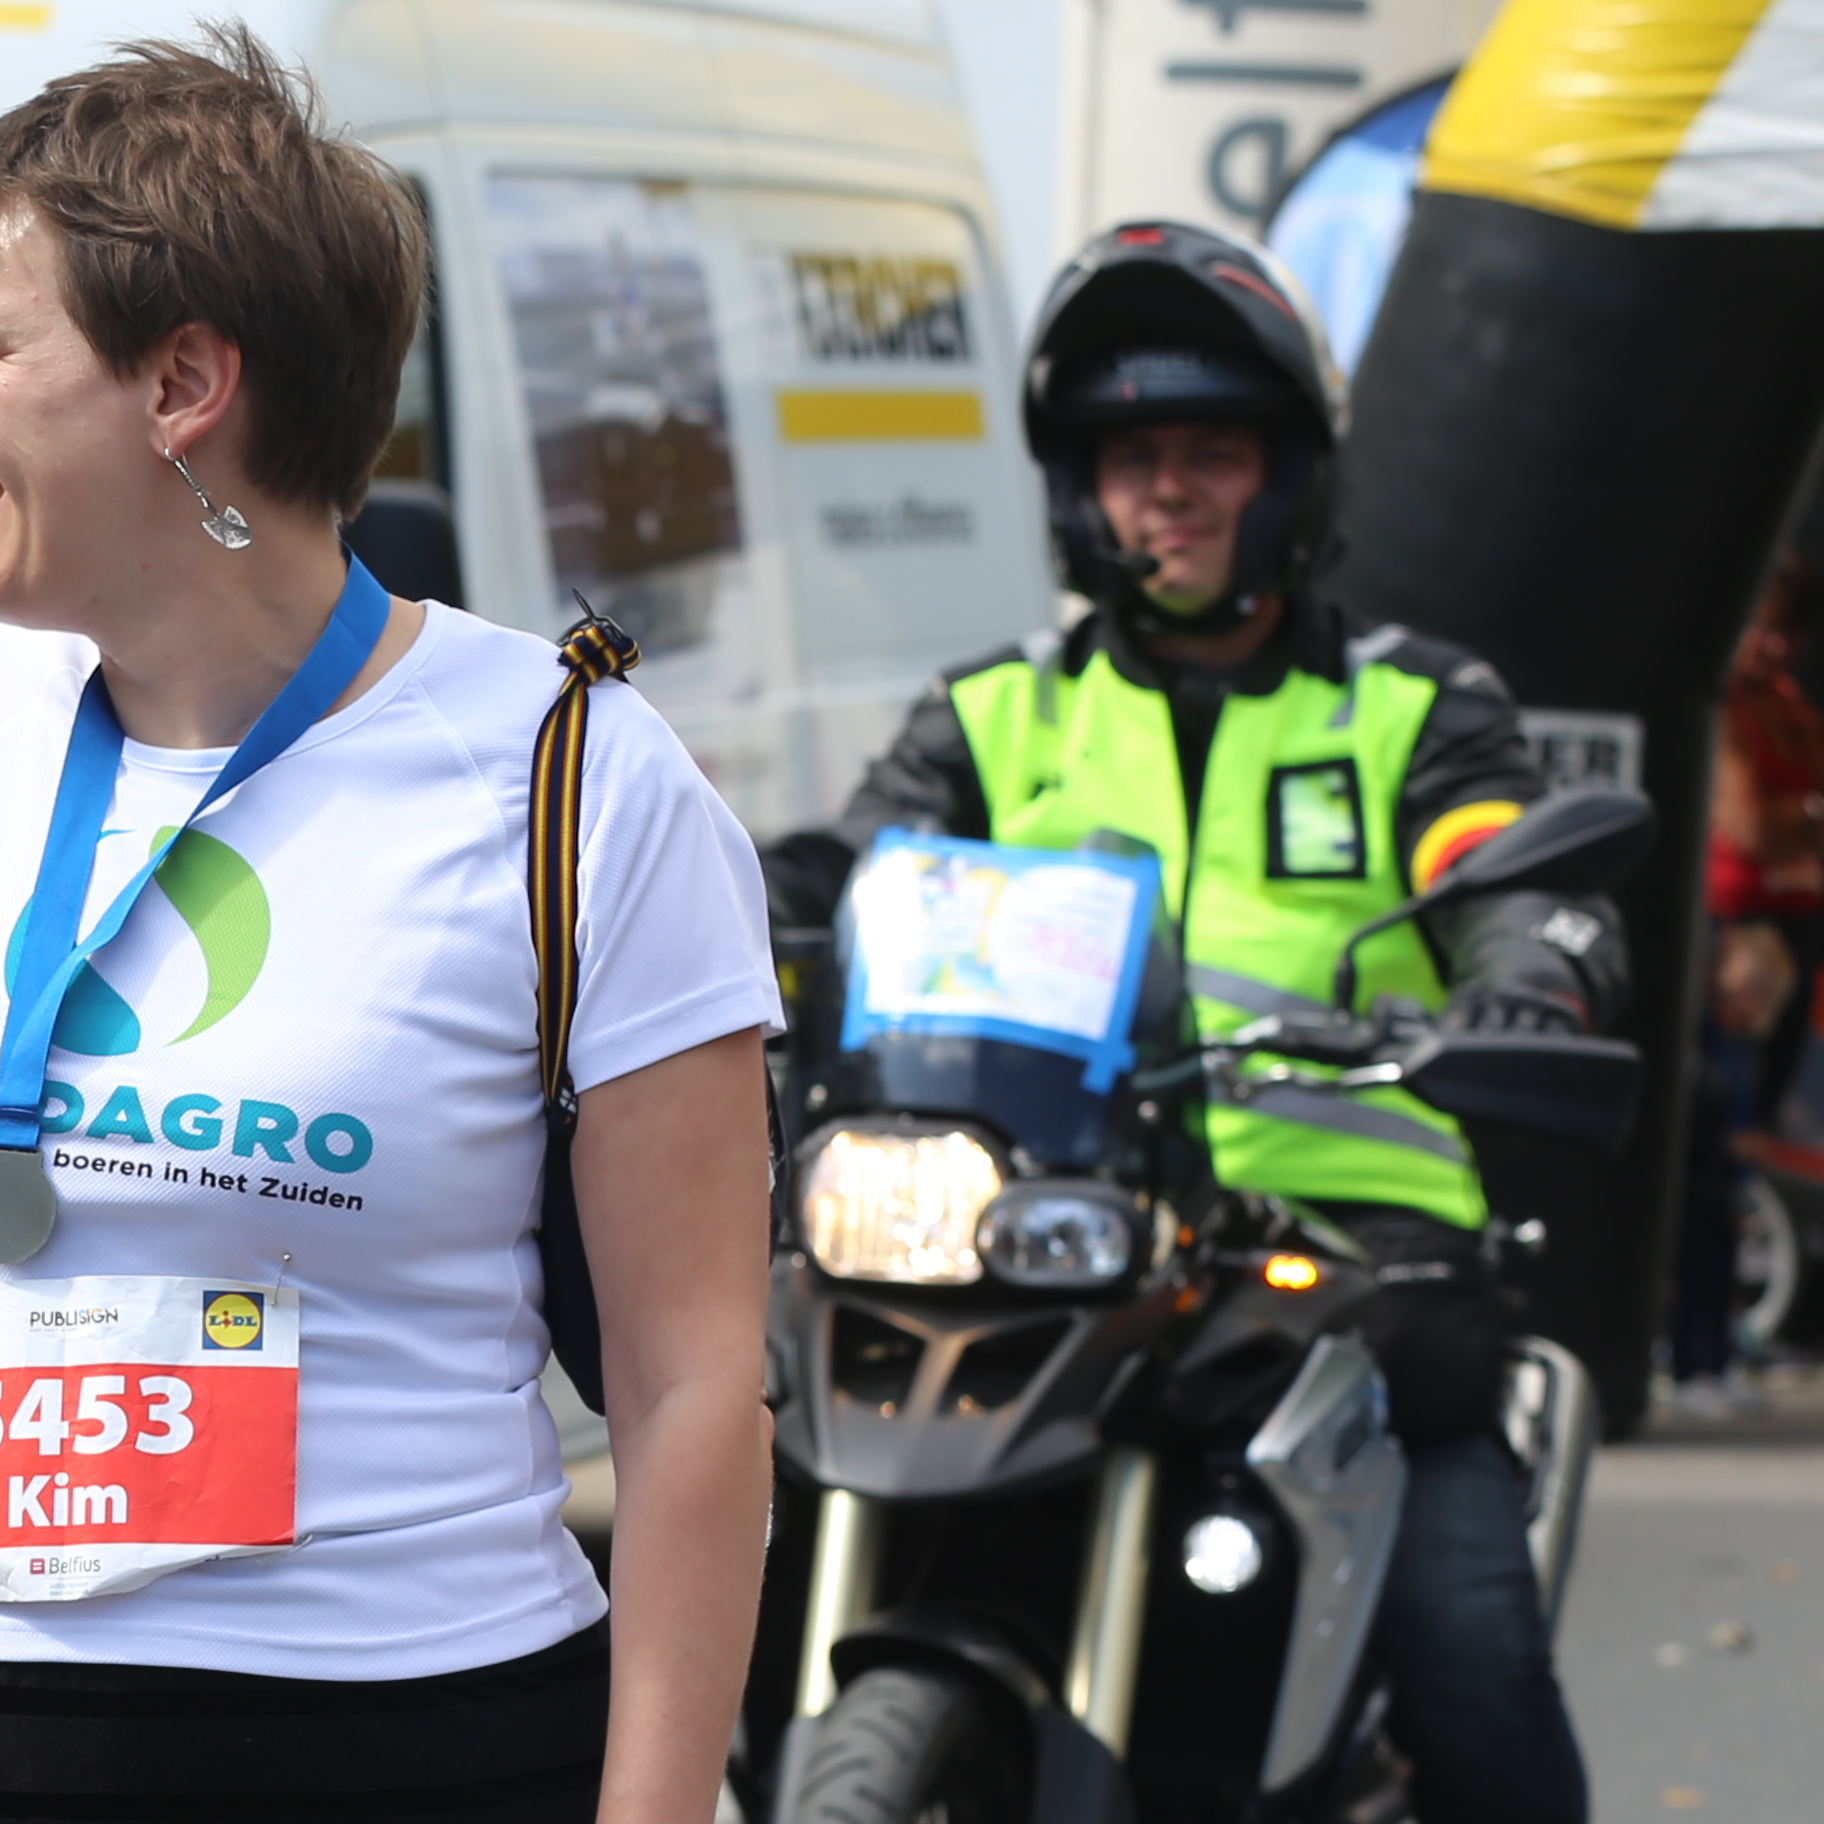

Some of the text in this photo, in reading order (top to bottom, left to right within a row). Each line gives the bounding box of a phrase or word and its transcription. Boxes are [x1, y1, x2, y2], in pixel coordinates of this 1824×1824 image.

[53, 1147, 153, 1179] boeren
[164, 1160, 189, 1185] in
[199, 1167, 248, 1195] het
[258, 1177, 364, 1212] Zuiden
[29, 1307, 121, 1327] PUBLISIGN
[8, 1471, 128, 1529] Kim
[49, 1557, 101, 1575] Belfius
